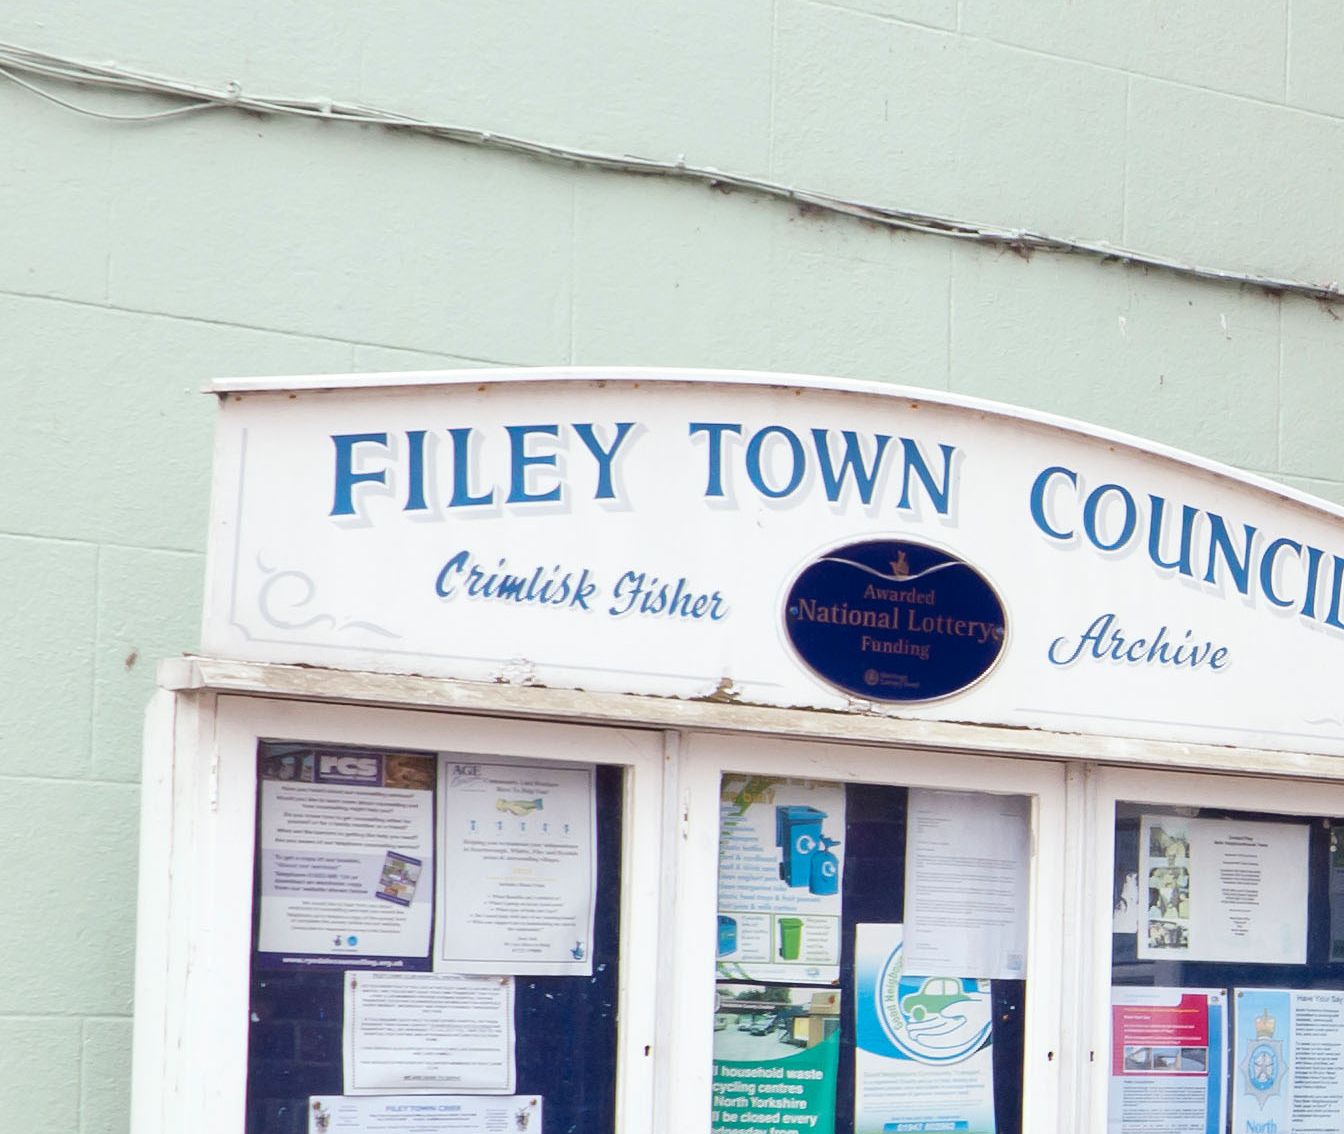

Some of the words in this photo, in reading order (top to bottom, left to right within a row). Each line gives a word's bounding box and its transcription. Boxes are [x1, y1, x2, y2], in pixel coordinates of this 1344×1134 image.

[329, 423, 637, 516] FILEY
[689, 423, 956, 515] TOWN
[435, 550, 595, 612] Crimlisk
[610, 572, 729, 621] Fisher
[864, 584, 935, 605] Awarded
[798, 598, 900, 630] National
[908, 608, 995, 644] Lottery
[861, 636, 931, 660] Funding
[1048, 613, 1230, 671] Archive
[721, 1065, 784, 1079] household
[786, 1069, 823, 1080] waste
[712, 1081, 756, 1096] cycling
[757, 1083, 803, 1094] centres
[714, 1096, 748, 1107] North
[750, 1096, 807, 1109] Yorkshire
[722, 1111, 738, 1122] be
[740, 1112, 780, 1123] closed
[782, 1114, 818, 1128] every
[1246, 1119, 1277, 1134] North
